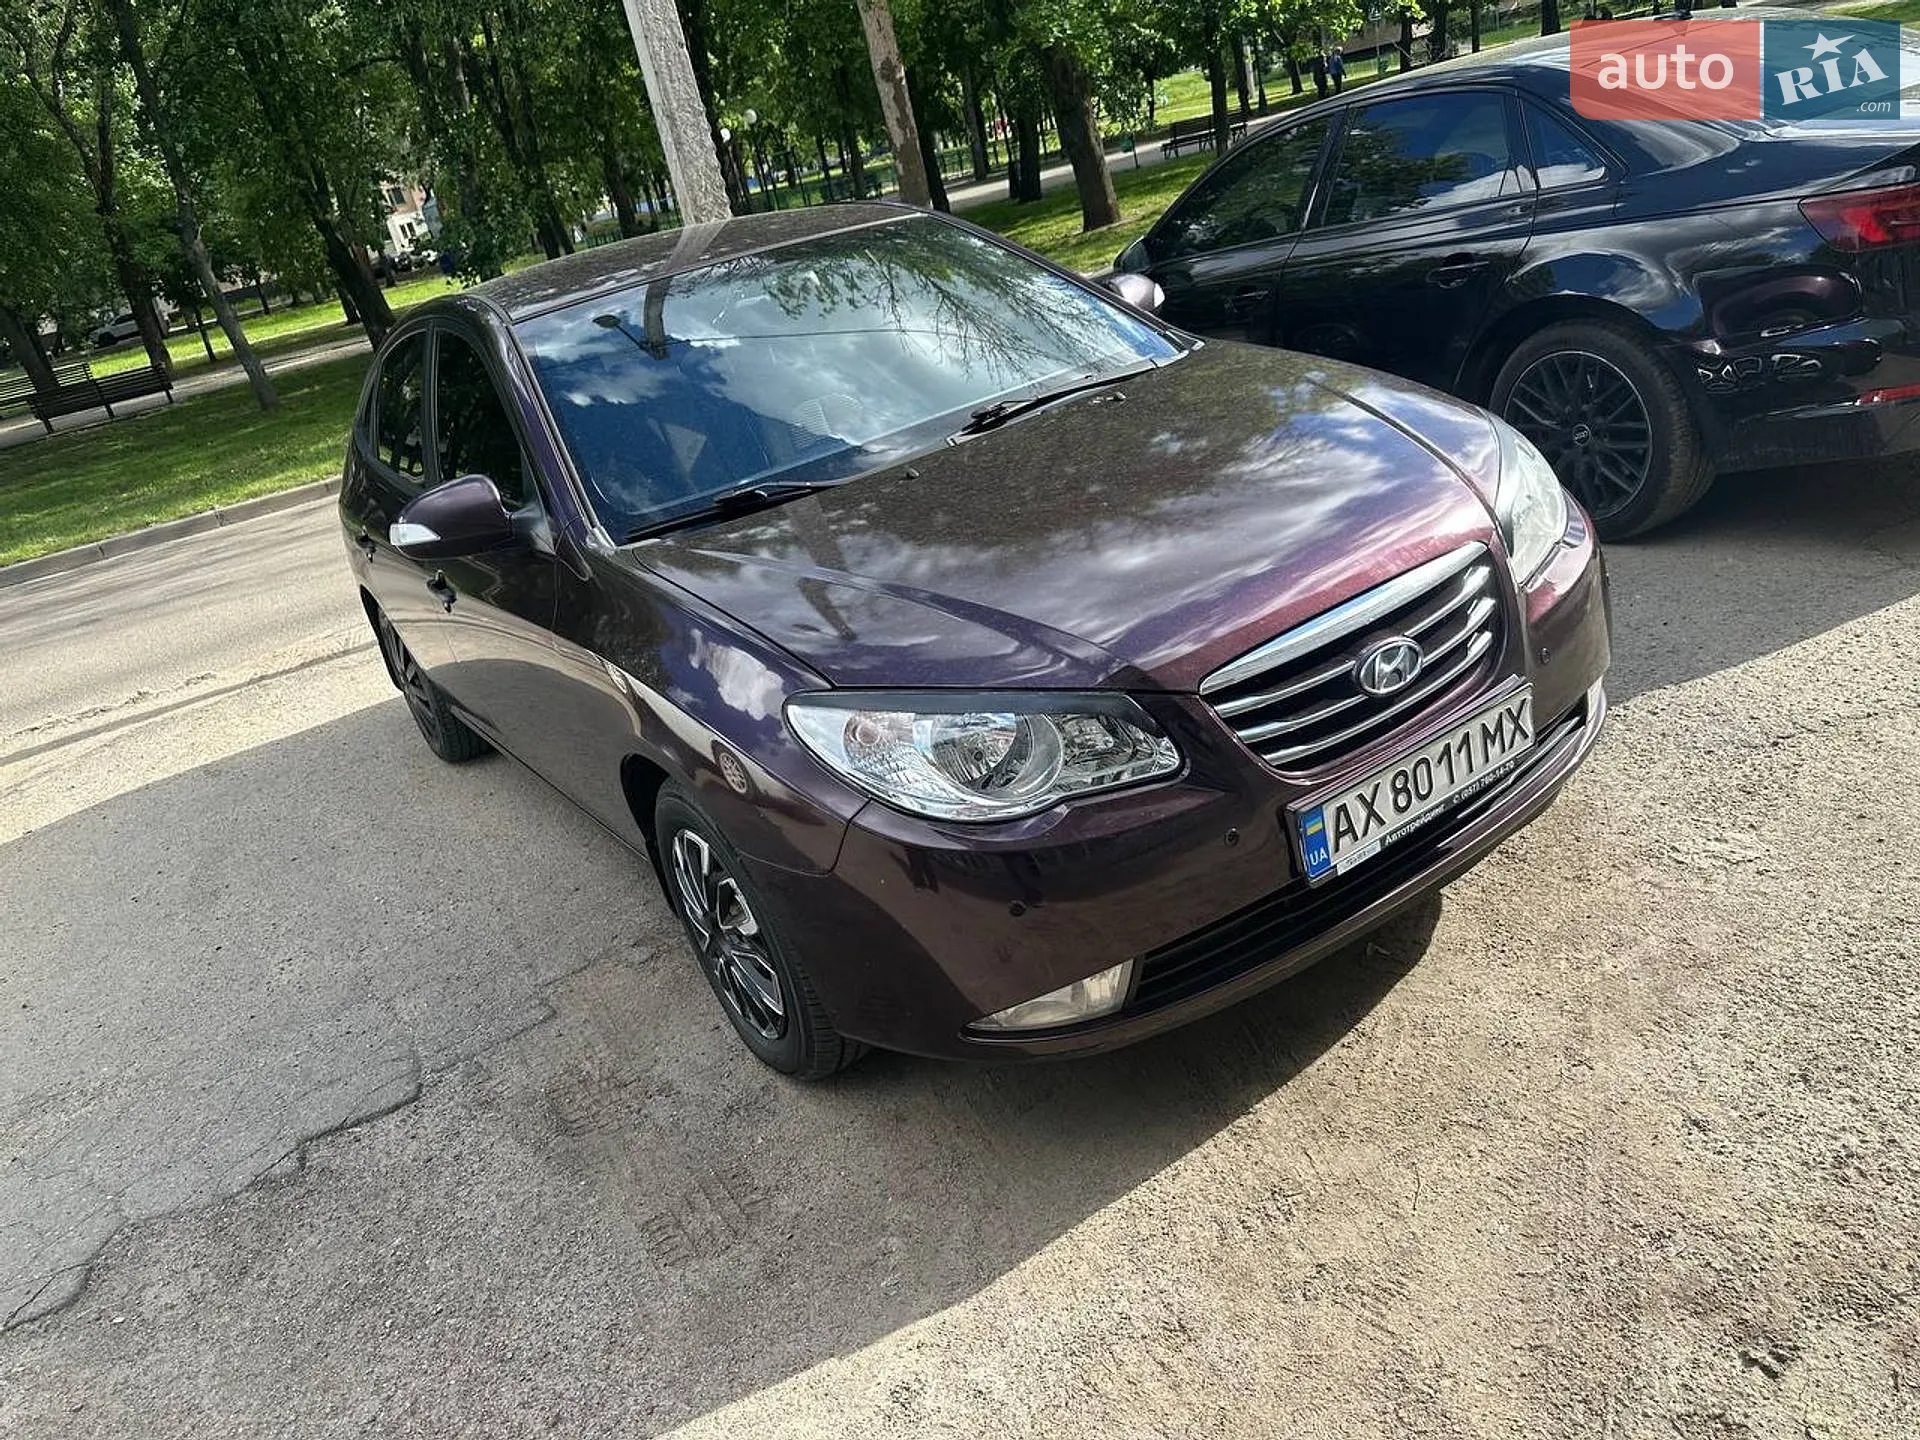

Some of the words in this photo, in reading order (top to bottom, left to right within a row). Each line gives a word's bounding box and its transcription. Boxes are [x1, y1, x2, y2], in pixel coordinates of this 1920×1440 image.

[1333, 781, 1386, 853] AX
[1390, 731, 1475, 816] 8011
[1480, 698, 1530, 764] MX
[1309, 847, 1329, 866] UA
